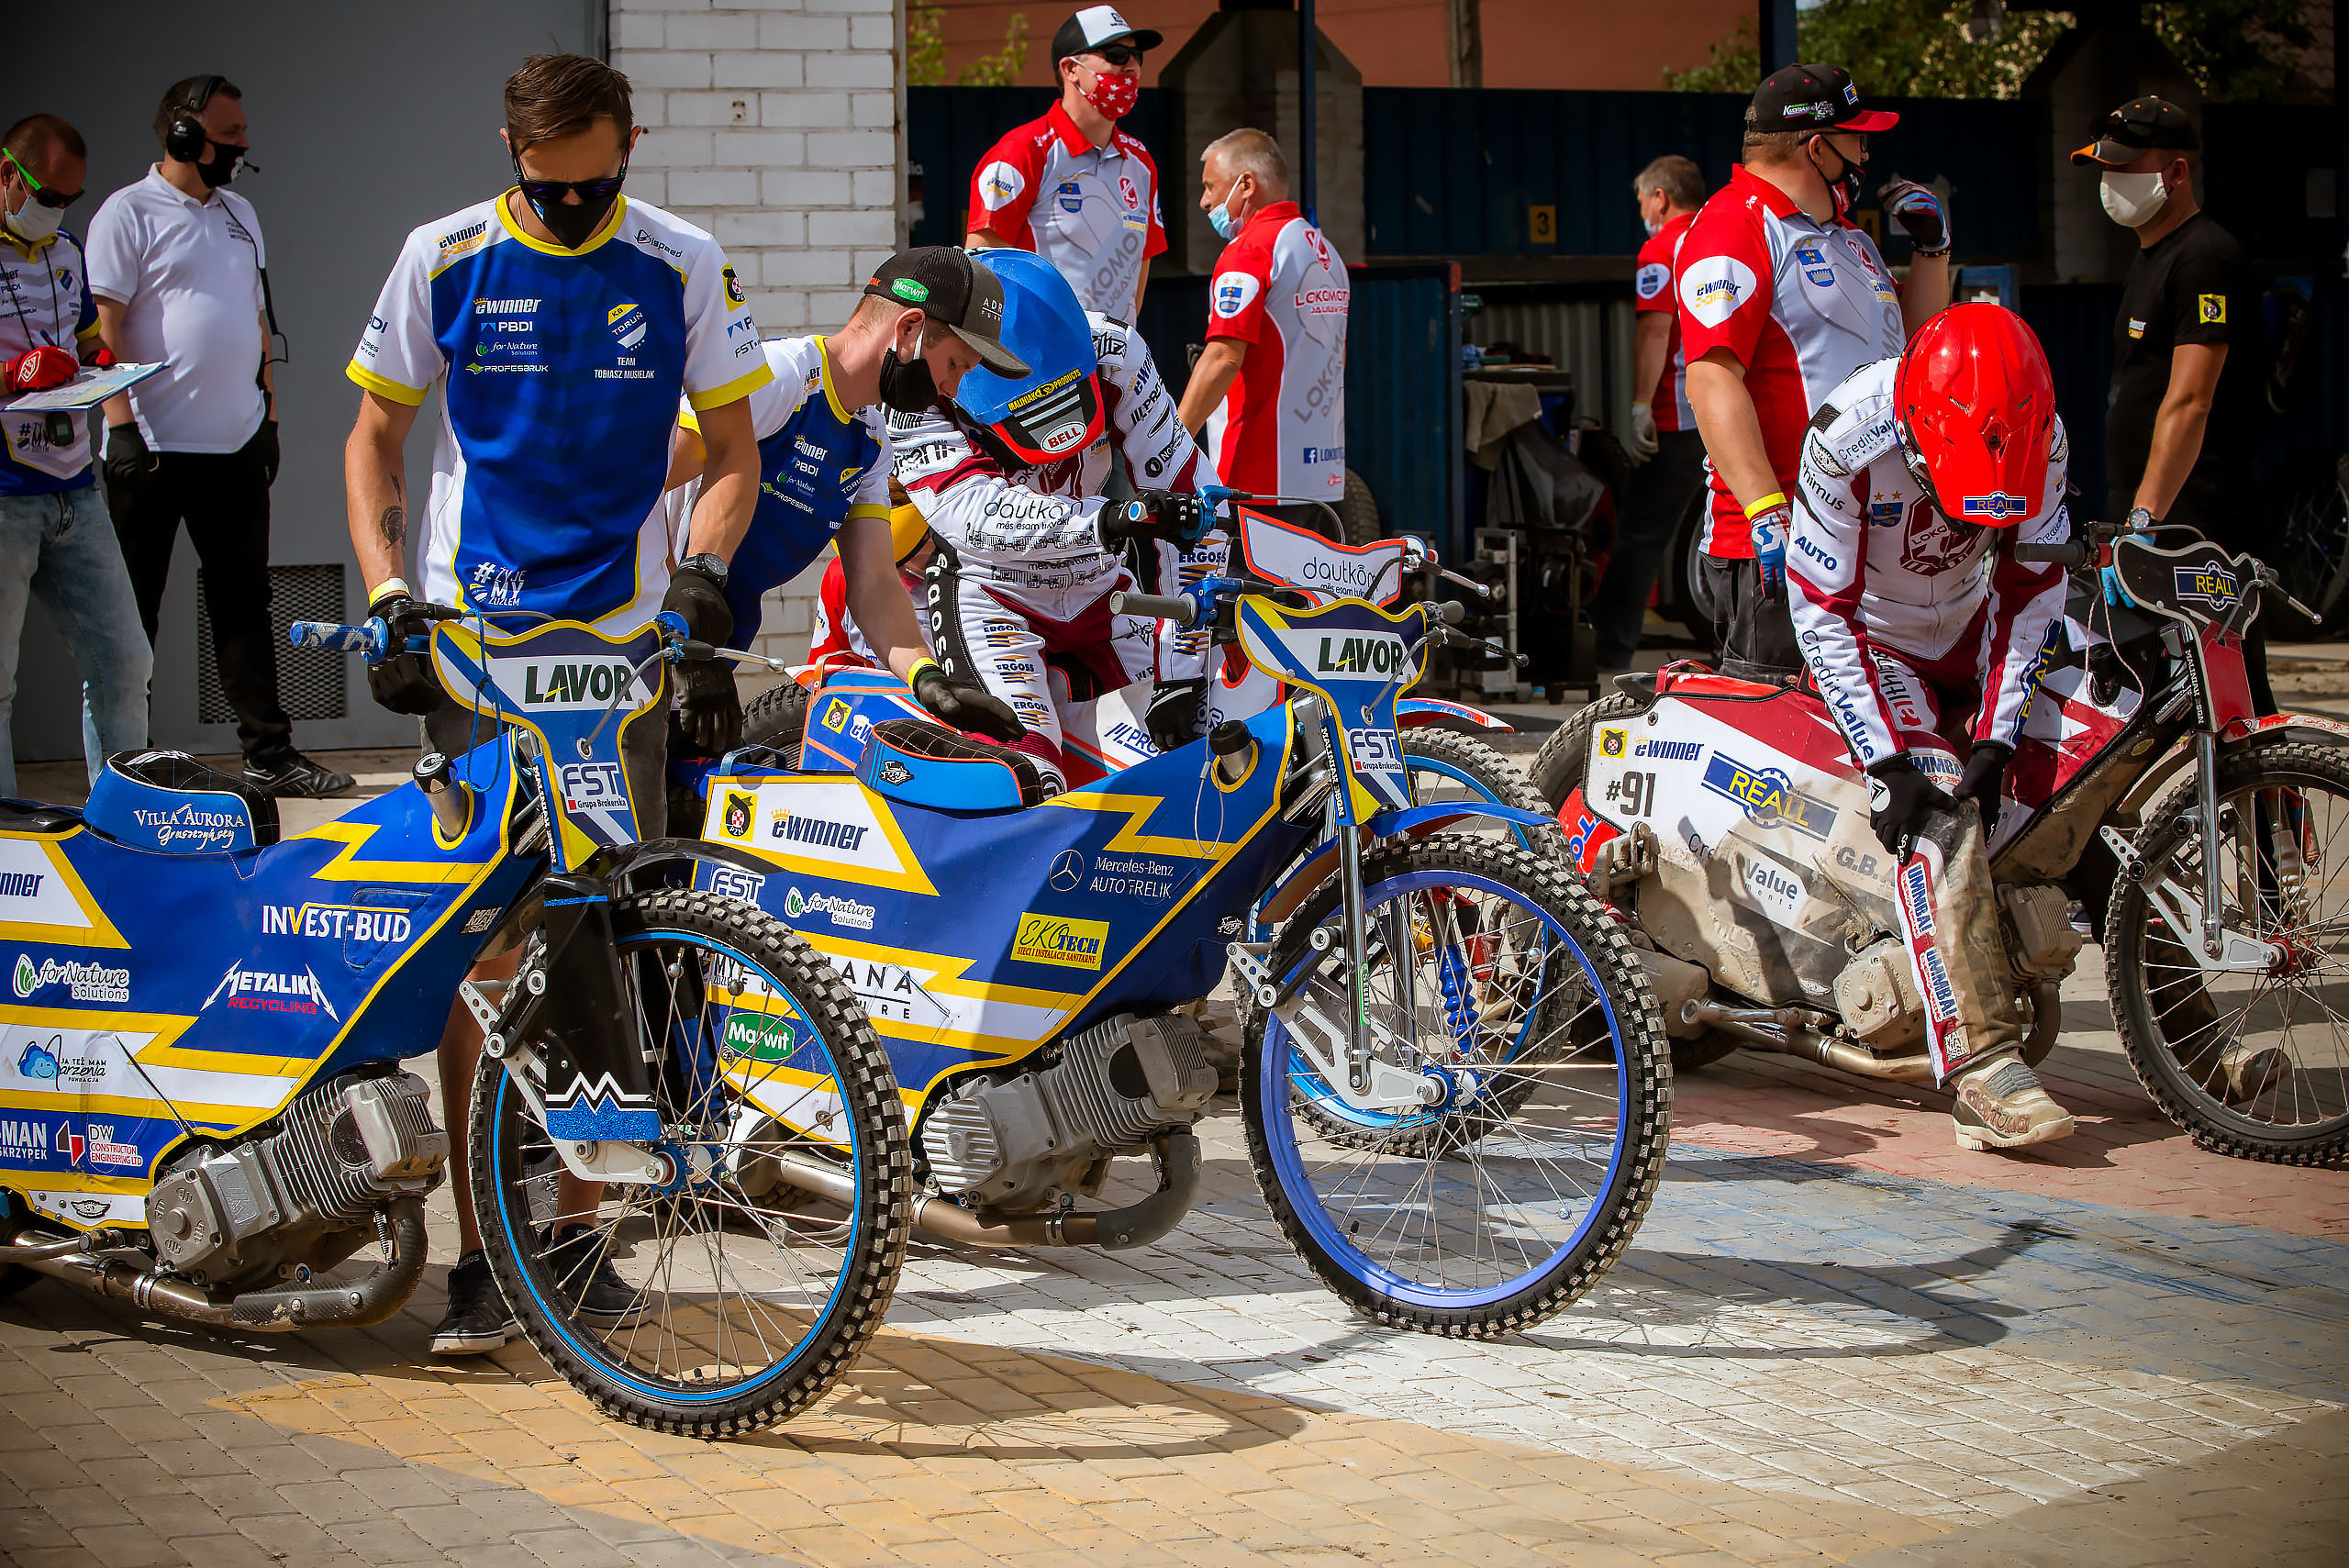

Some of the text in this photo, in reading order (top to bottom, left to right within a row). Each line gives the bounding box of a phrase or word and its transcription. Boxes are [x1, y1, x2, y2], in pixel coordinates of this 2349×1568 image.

[1536, 211, 1550, 235] 3
[983, 297, 1002, 312] ADR
[498, 320, 532, 331] PBDI
[484, 364, 549, 373] PROFESBRUK
[618, 357, 636, 366] TEAM
[595, 369, 655, 379] TOBIASZ MUSIELAK
[1008, 368, 1082, 412] MALINIAK PRODUCTS
[1047, 427, 1082, 449] BELL
[795, 460, 819, 477] PBDI
[1976, 500, 2016, 511] REALL
[1178, 551, 1227, 563] ERGOSS
[1794, 535, 1837, 571] AUTO
[491, 581, 524, 599] MY
[2195, 574, 2235, 596] REALL
[1318, 637, 1405, 675] LAVOR
[524, 664, 633, 704] LAVOR
[1013, 701, 1050, 713] ERGOSS
[1350, 730, 1394, 759] FST
[1634, 740, 1705, 761] eWinner
[1363, 762, 1379, 771] Grupa
[562, 764, 618, 797] FST
[1606, 771, 1656, 817] #91
[1728, 770, 1809, 827] REALL
[577, 798, 627, 809] Grupa Brokerska
[133, 807, 246, 828] VILLA AURORA
[772, 815, 868, 851] eWinner
[0, 873, 44, 897] nner
[713, 871, 764, 901] FST
[1089, 876, 1126, 894] AUTO
[262, 903, 410, 942] INVEST-BUD
[832, 914, 872, 929] Solutions
[1017, 946, 1031, 955] SIECI
[1036, 948, 1066, 961] INSTALACJE
[1066, 951, 1097, 964] SANITARNE
[72, 985, 128, 1000] Solutions
[201, 958, 340, 1023] METALIKA
[228, 996, 317, 1014] RECYCLING
[728, 1021, 791, 1051] Marwit
[72, 1057, 84, 1065] TEŻ
[0, 1120, 47, 1148] MAN
[89, 1125, 114, 1142] DW
[91, 1143, 137, 1155] CONSTRUCTION
[91, 1152, 142, 1165] ENGINEERING LTD
